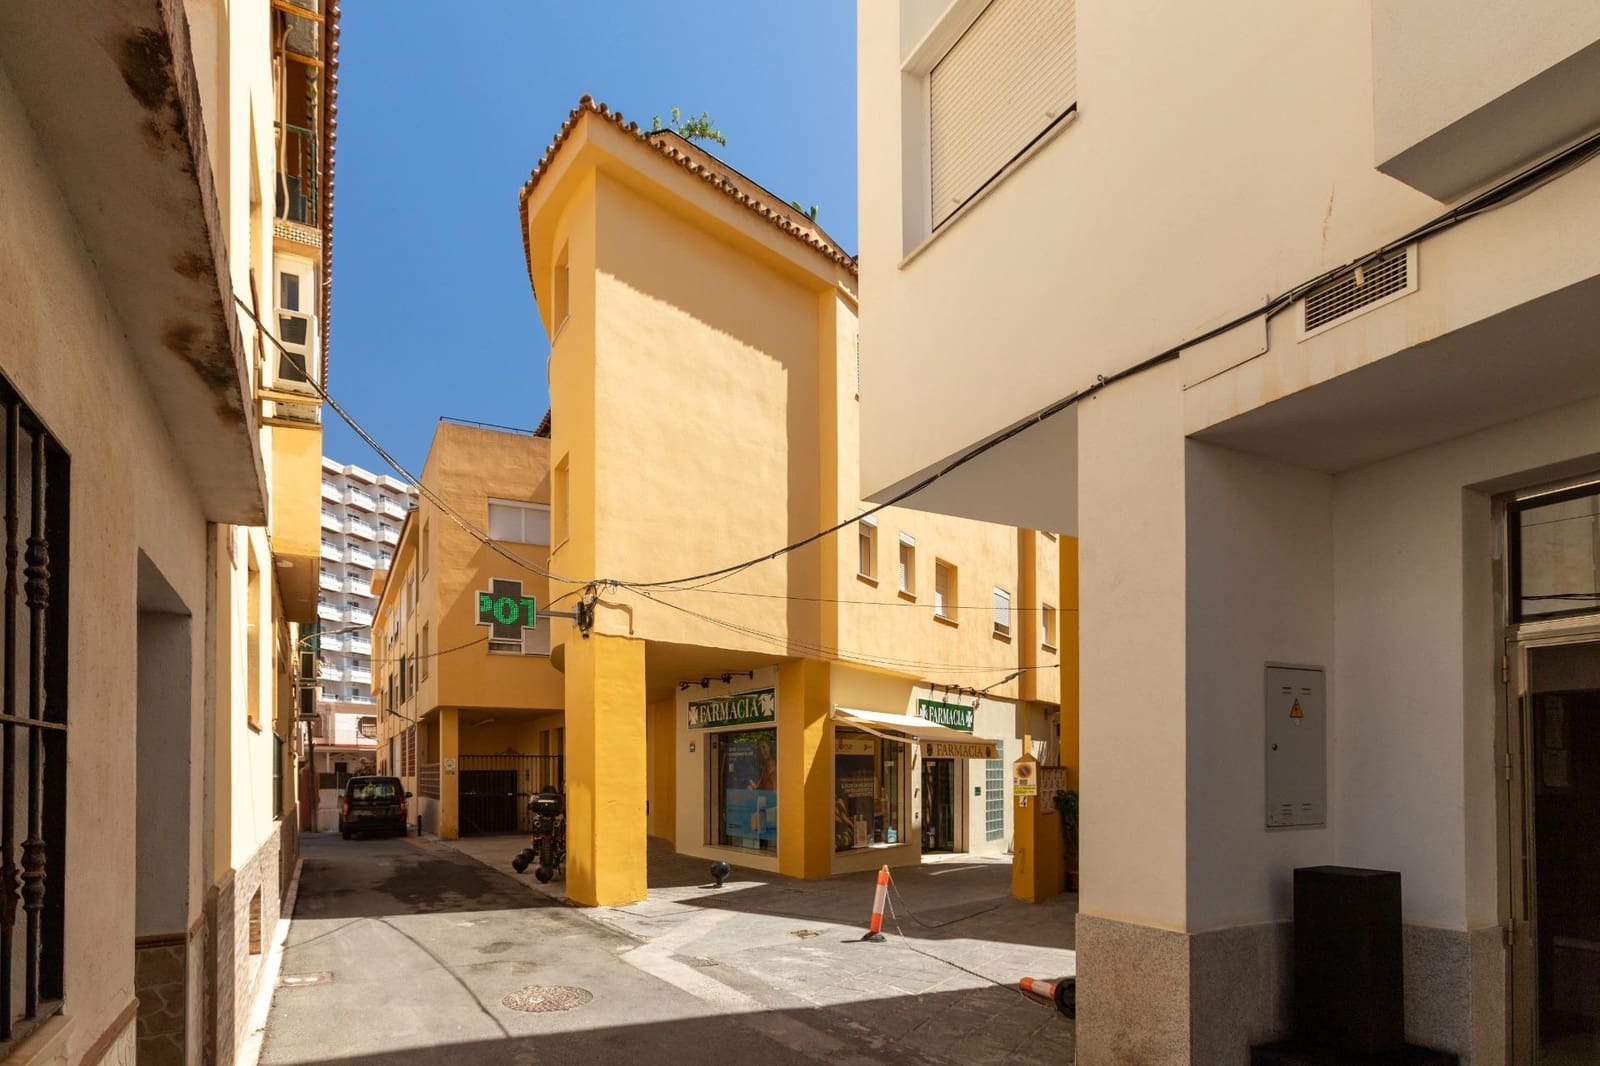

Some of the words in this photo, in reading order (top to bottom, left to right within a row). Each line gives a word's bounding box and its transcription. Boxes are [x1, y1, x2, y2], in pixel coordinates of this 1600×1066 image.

[699, 698, 759, 723] FARMACIA
[928, 706, 965, 726] FARMACIA
[936, 743, 984, 757] FARMACIA
